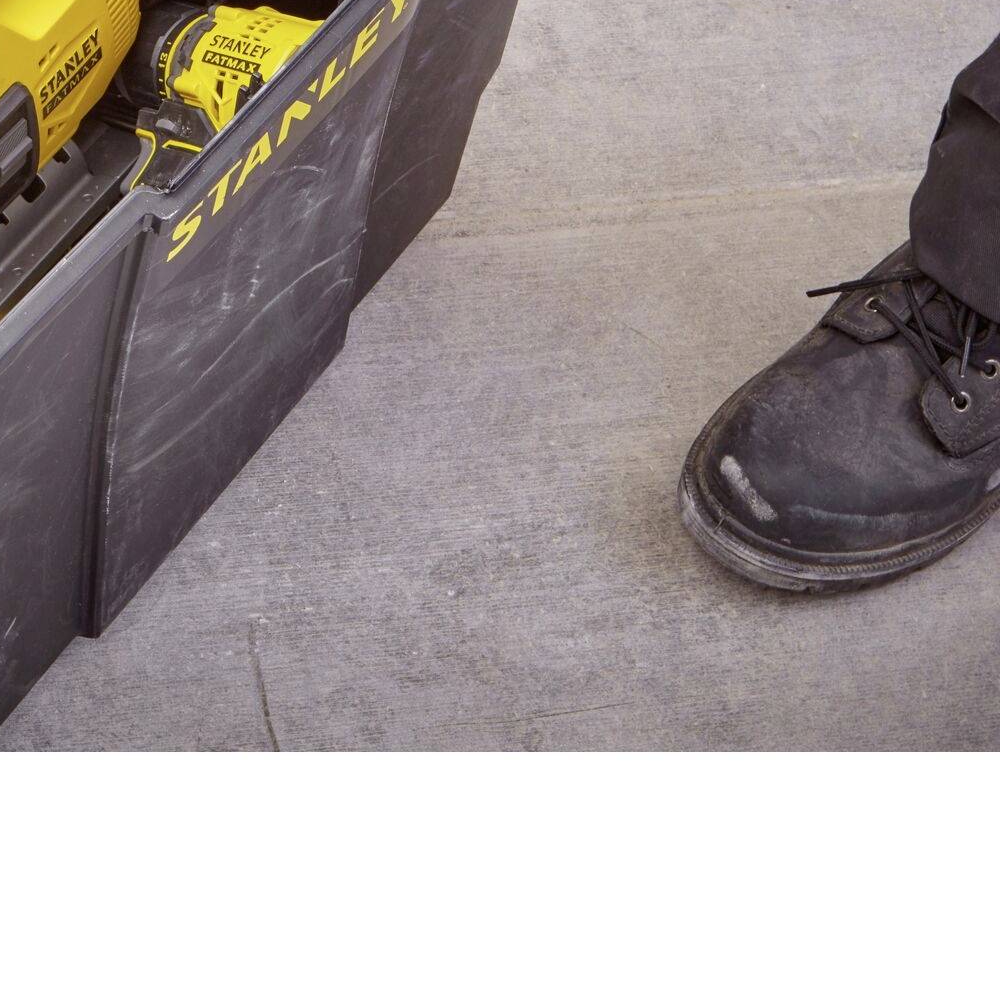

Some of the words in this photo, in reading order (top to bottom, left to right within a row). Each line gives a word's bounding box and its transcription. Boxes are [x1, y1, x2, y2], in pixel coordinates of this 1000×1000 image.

[40, 27, 99, 104] STANLEY
[204, 51, 257, 74] FATMAX
[209, 34, 271, 60] STANLEY
[45, 54, 99, 114] FATMAX
